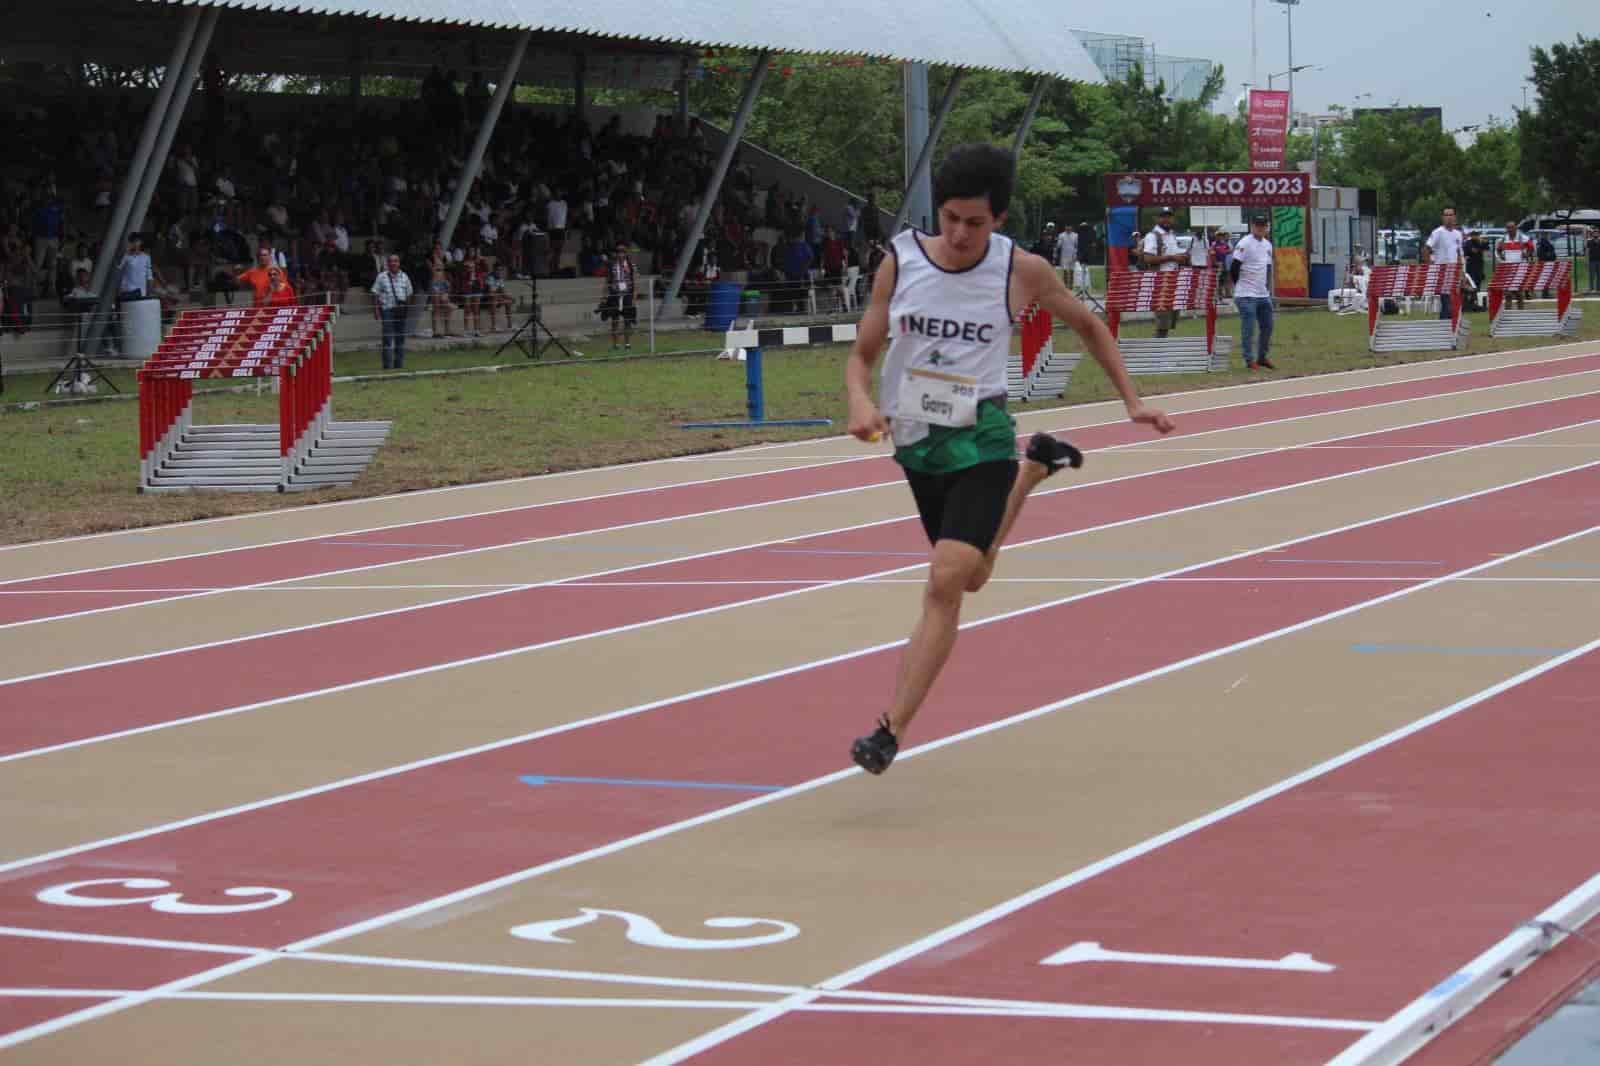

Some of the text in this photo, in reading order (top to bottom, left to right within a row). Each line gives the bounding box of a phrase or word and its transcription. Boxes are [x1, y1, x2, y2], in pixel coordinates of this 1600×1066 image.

[1150, 177, 1303, 195] TABASCO 2023
[899, 314, 994, 344] INEDEC
[36, 877, 293, 915] 3
[510, 907, 801, 951] 2
[1039, 941, 1336, 974] 1
